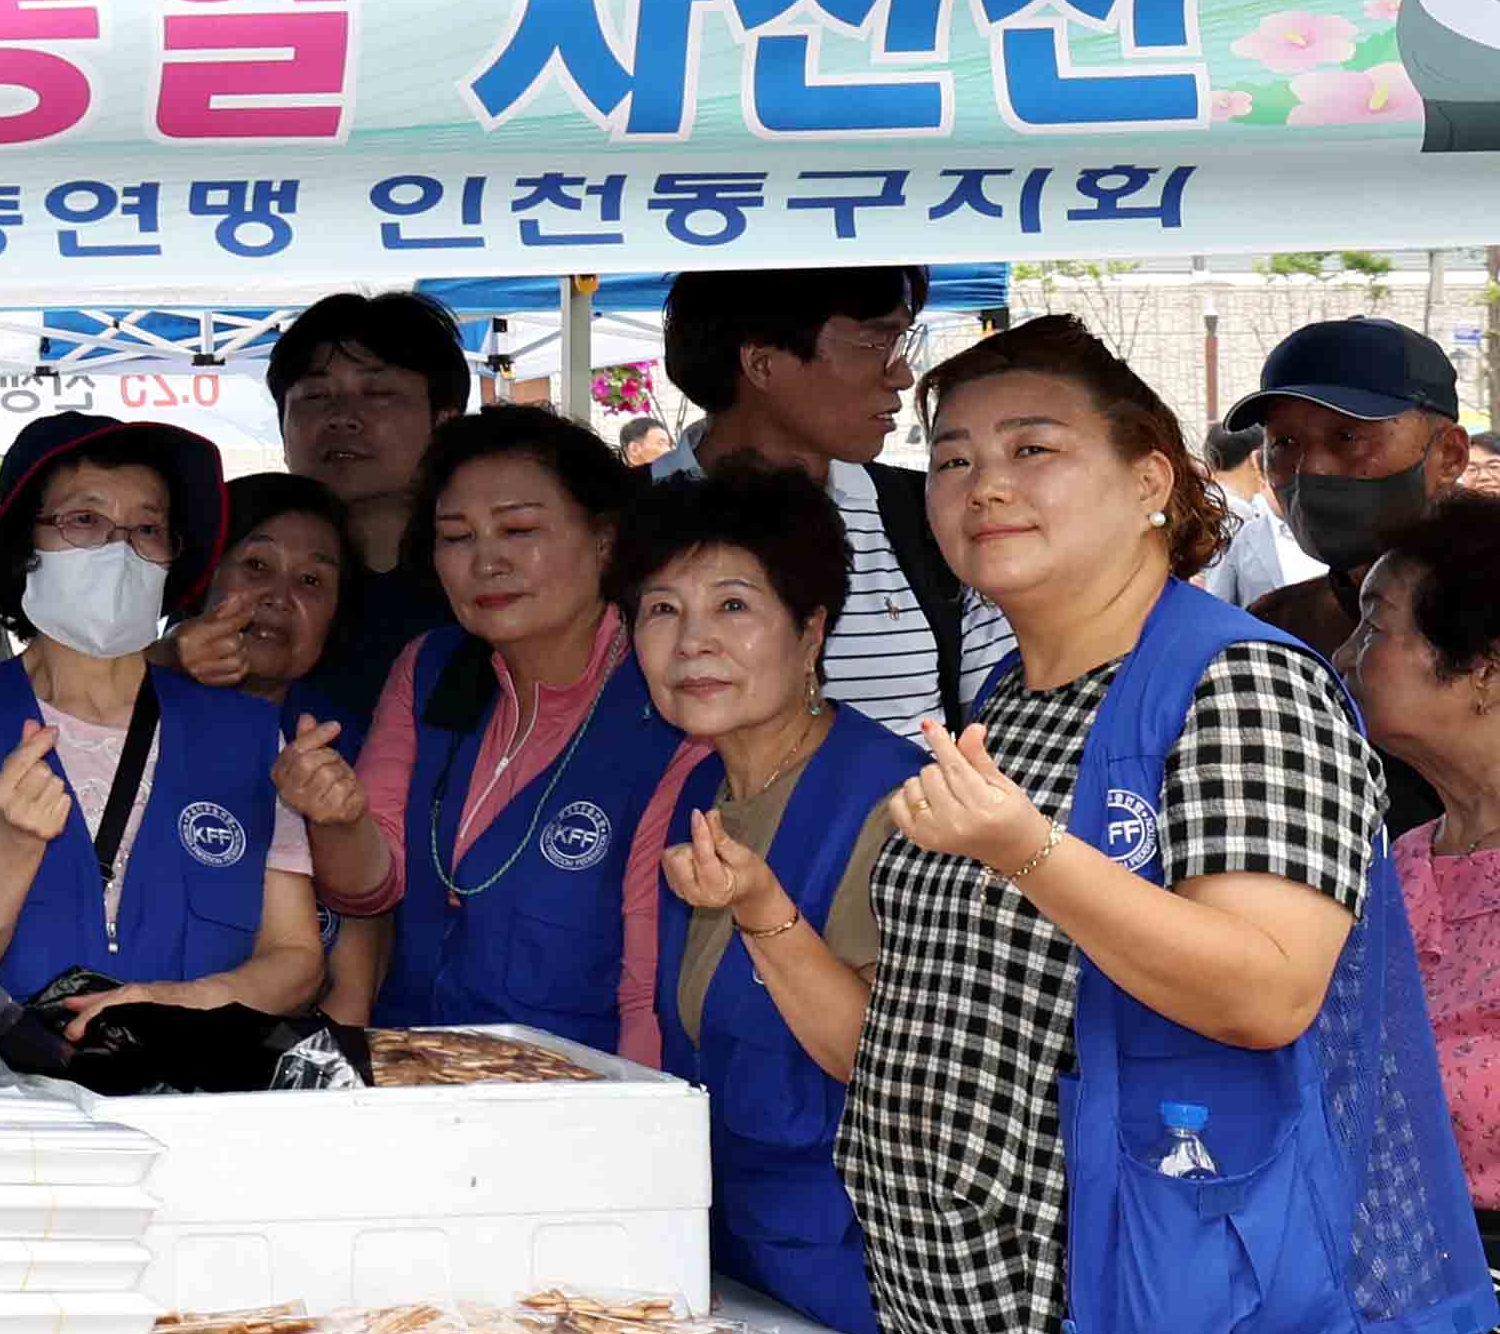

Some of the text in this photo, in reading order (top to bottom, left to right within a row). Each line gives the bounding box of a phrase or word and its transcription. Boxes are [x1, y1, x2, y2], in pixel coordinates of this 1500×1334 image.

[368, 163, 1198, 251] 인천동구지회
[192, 825, 232, 846] KFF
[554, 825, 598, 849] KFF
[1107, 818, 1142, 846] FF
